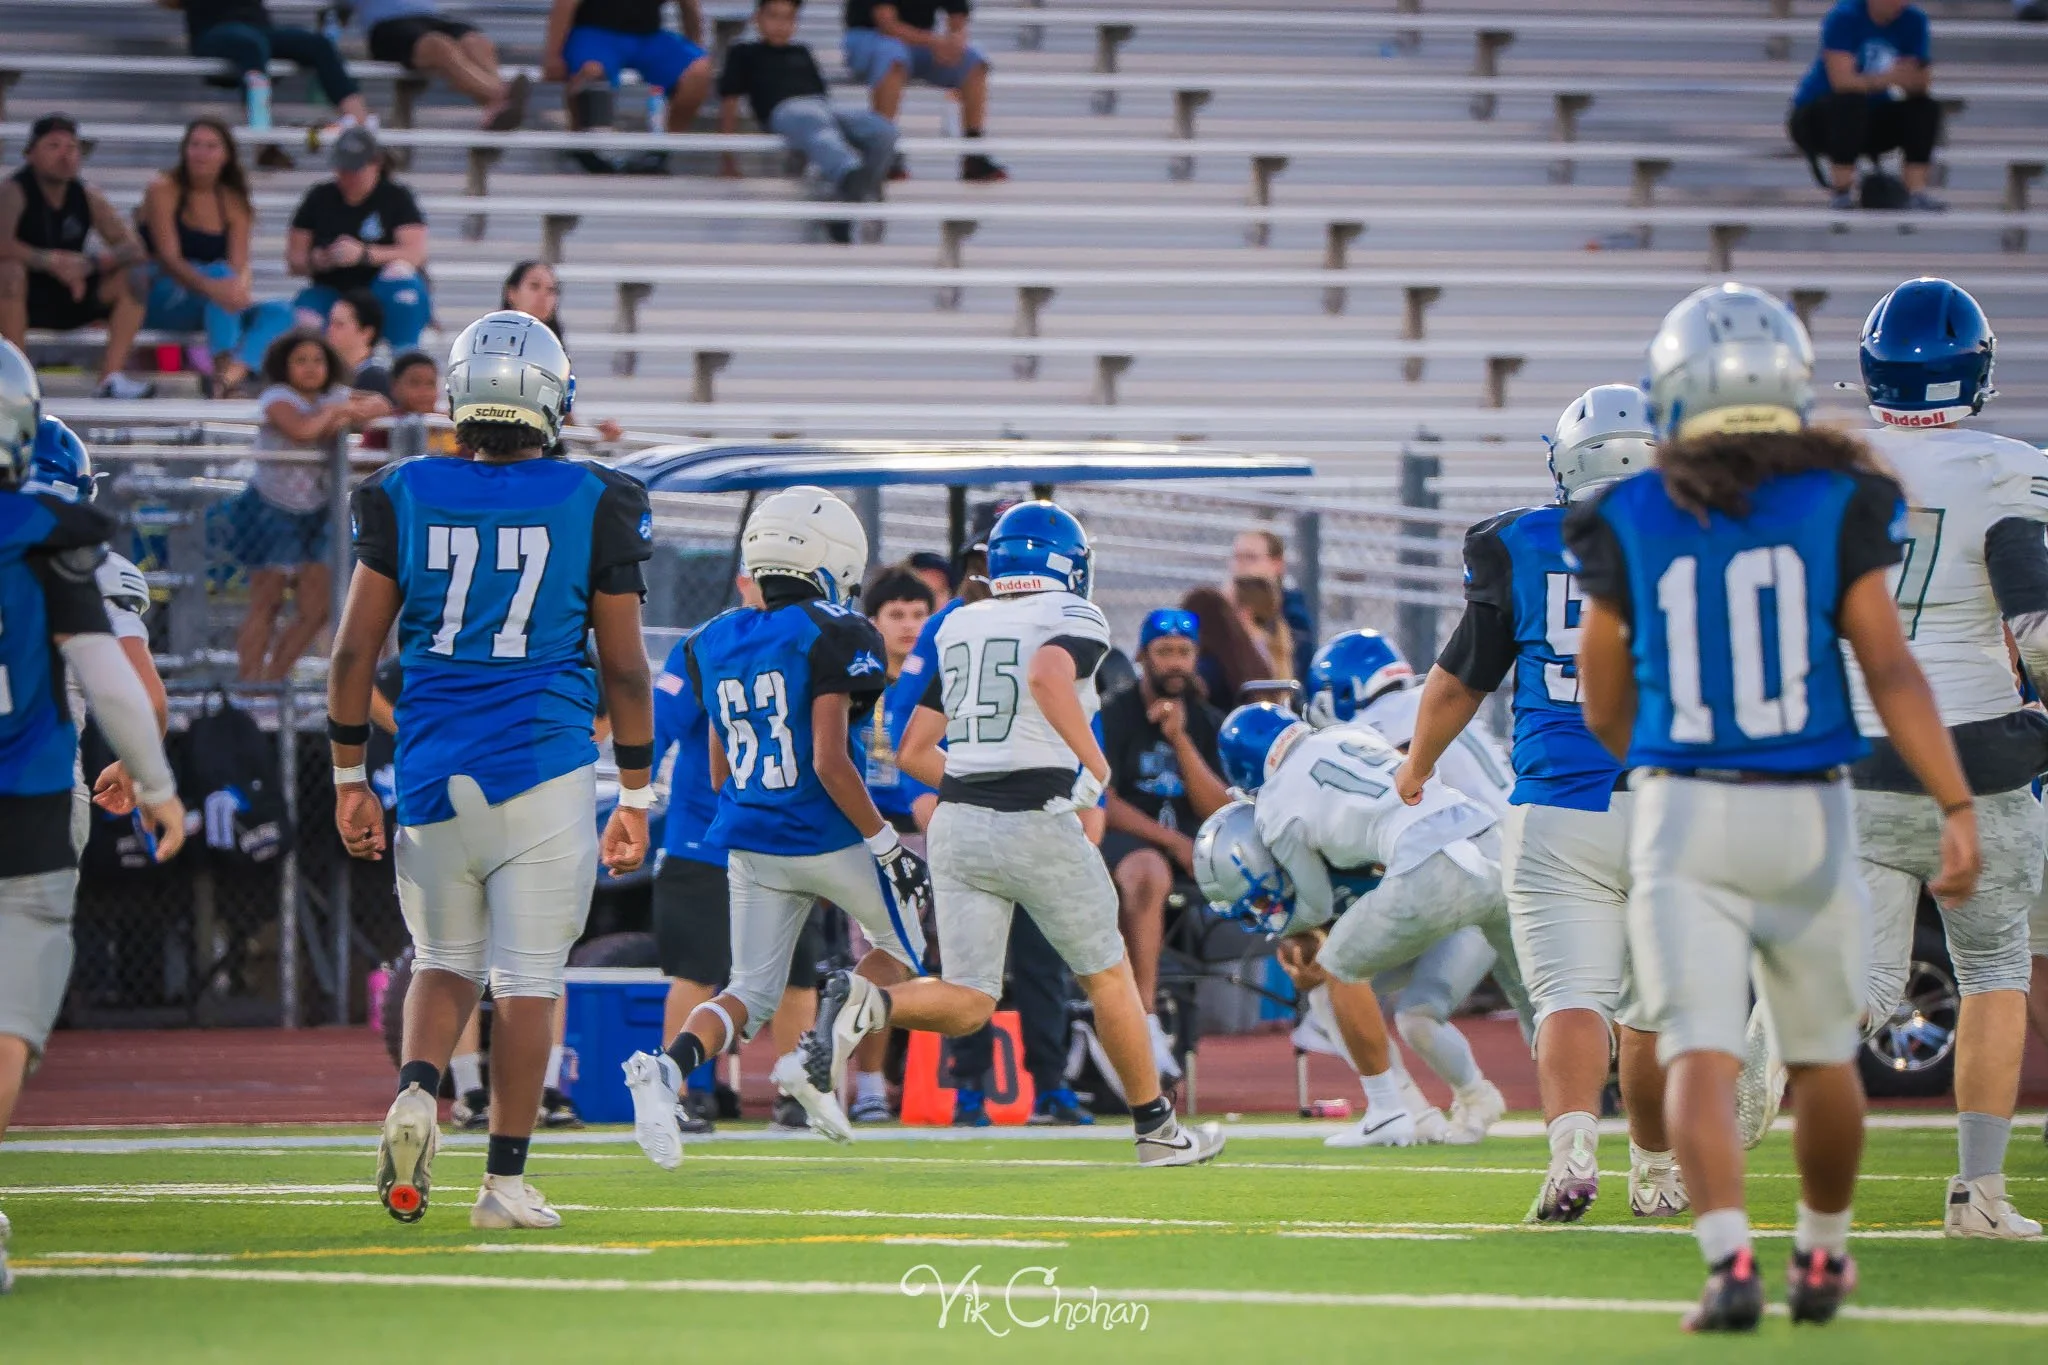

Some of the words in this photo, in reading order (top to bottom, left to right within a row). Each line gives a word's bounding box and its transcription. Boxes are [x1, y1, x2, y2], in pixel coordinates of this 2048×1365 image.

[475, 406, 517, 418] schutt
[1882, 411, 1946, 427] Riddell
[427, 525, 550, 658] 77
[995, 578, 1042, 592] Riddell
[944, 637, 1020, 744] 25
[1657, 544, 1810, 744] 10
[716, 671, 799, 790] 63
